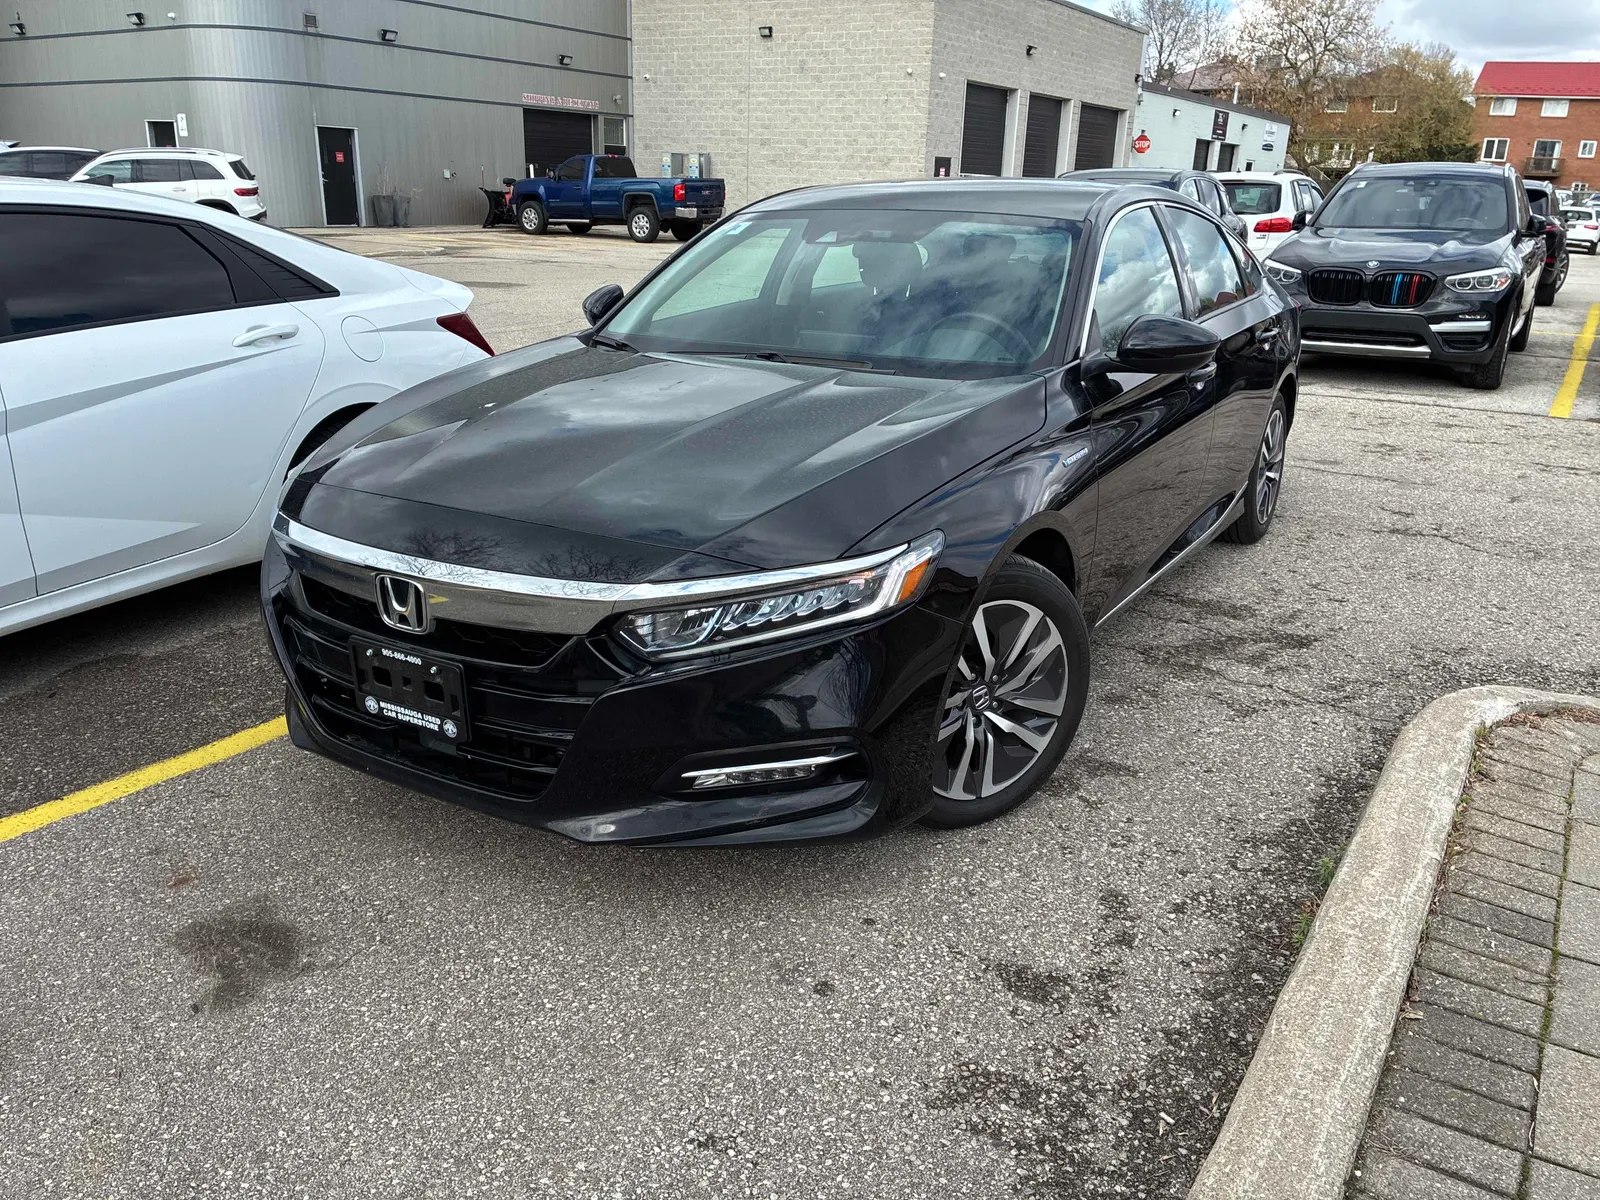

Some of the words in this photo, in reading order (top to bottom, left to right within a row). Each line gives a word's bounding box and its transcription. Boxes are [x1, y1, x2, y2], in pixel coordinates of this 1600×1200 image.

[1134, 139, 1150, 149] STOP
[379, 700, 423, 719] MISSISSAUGA
[422, 714, 441, 725] USED
[383, 708, 397, 719] CAR
[397, 713, 440, 732] SUPERSTORE
